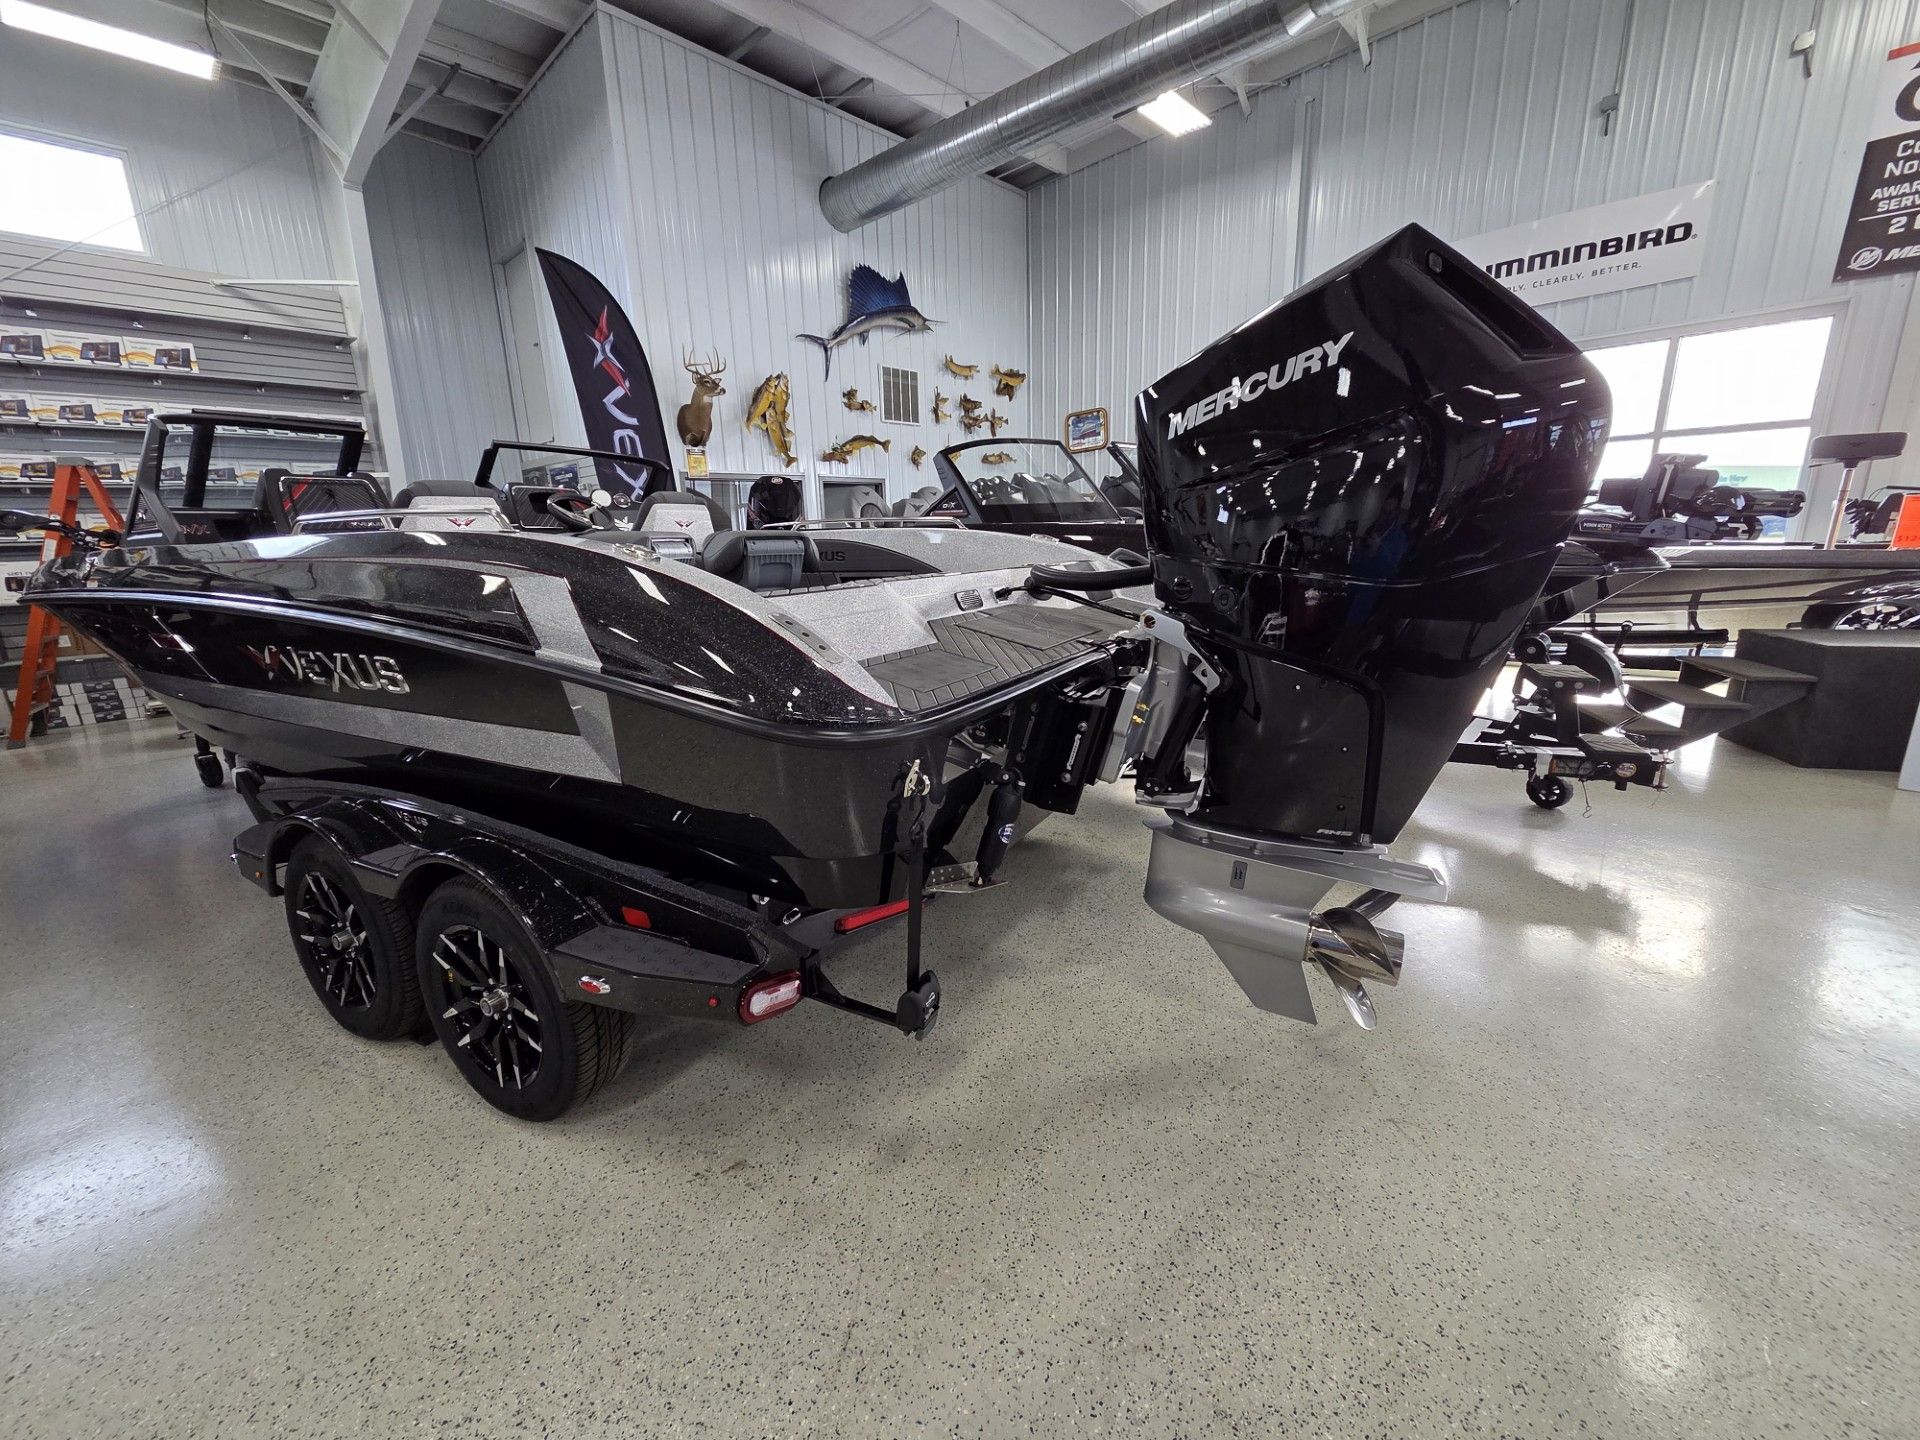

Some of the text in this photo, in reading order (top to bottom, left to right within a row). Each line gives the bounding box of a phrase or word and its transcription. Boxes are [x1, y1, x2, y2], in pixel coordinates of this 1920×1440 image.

[1887, 216, 1908, 235] 2
[1532, 272, 1584, 289] CLEARLY.
[1591, 261, 1642, 277] BETTER.
[1168, 331, 1354, 440] MERCURY
[268, 645, 411, 694] VEXUS
